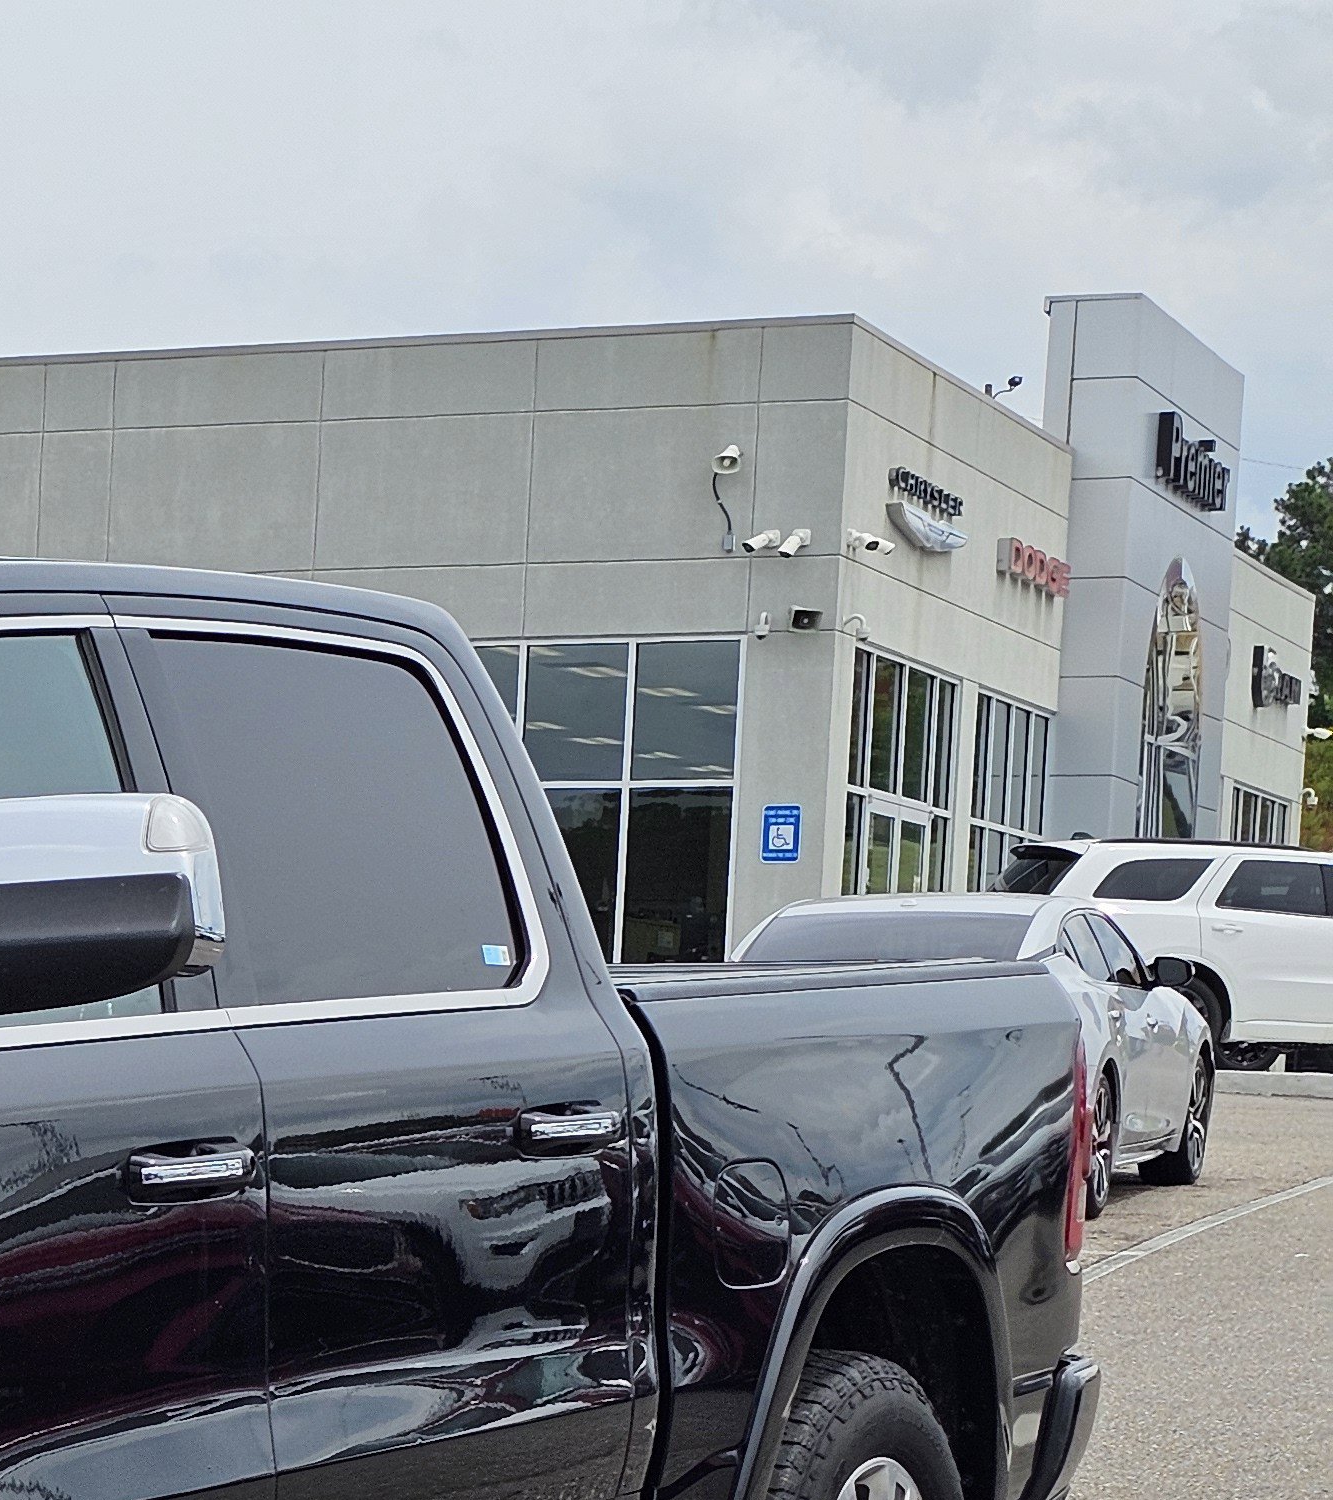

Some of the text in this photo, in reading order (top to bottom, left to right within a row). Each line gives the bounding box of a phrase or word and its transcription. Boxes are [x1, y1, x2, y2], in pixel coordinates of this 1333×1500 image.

[890, 466, 964, 516] CHRYSLER
[1159, 411, 1230, 511] Premier
[997, 537, 1071, 599] DODGE
